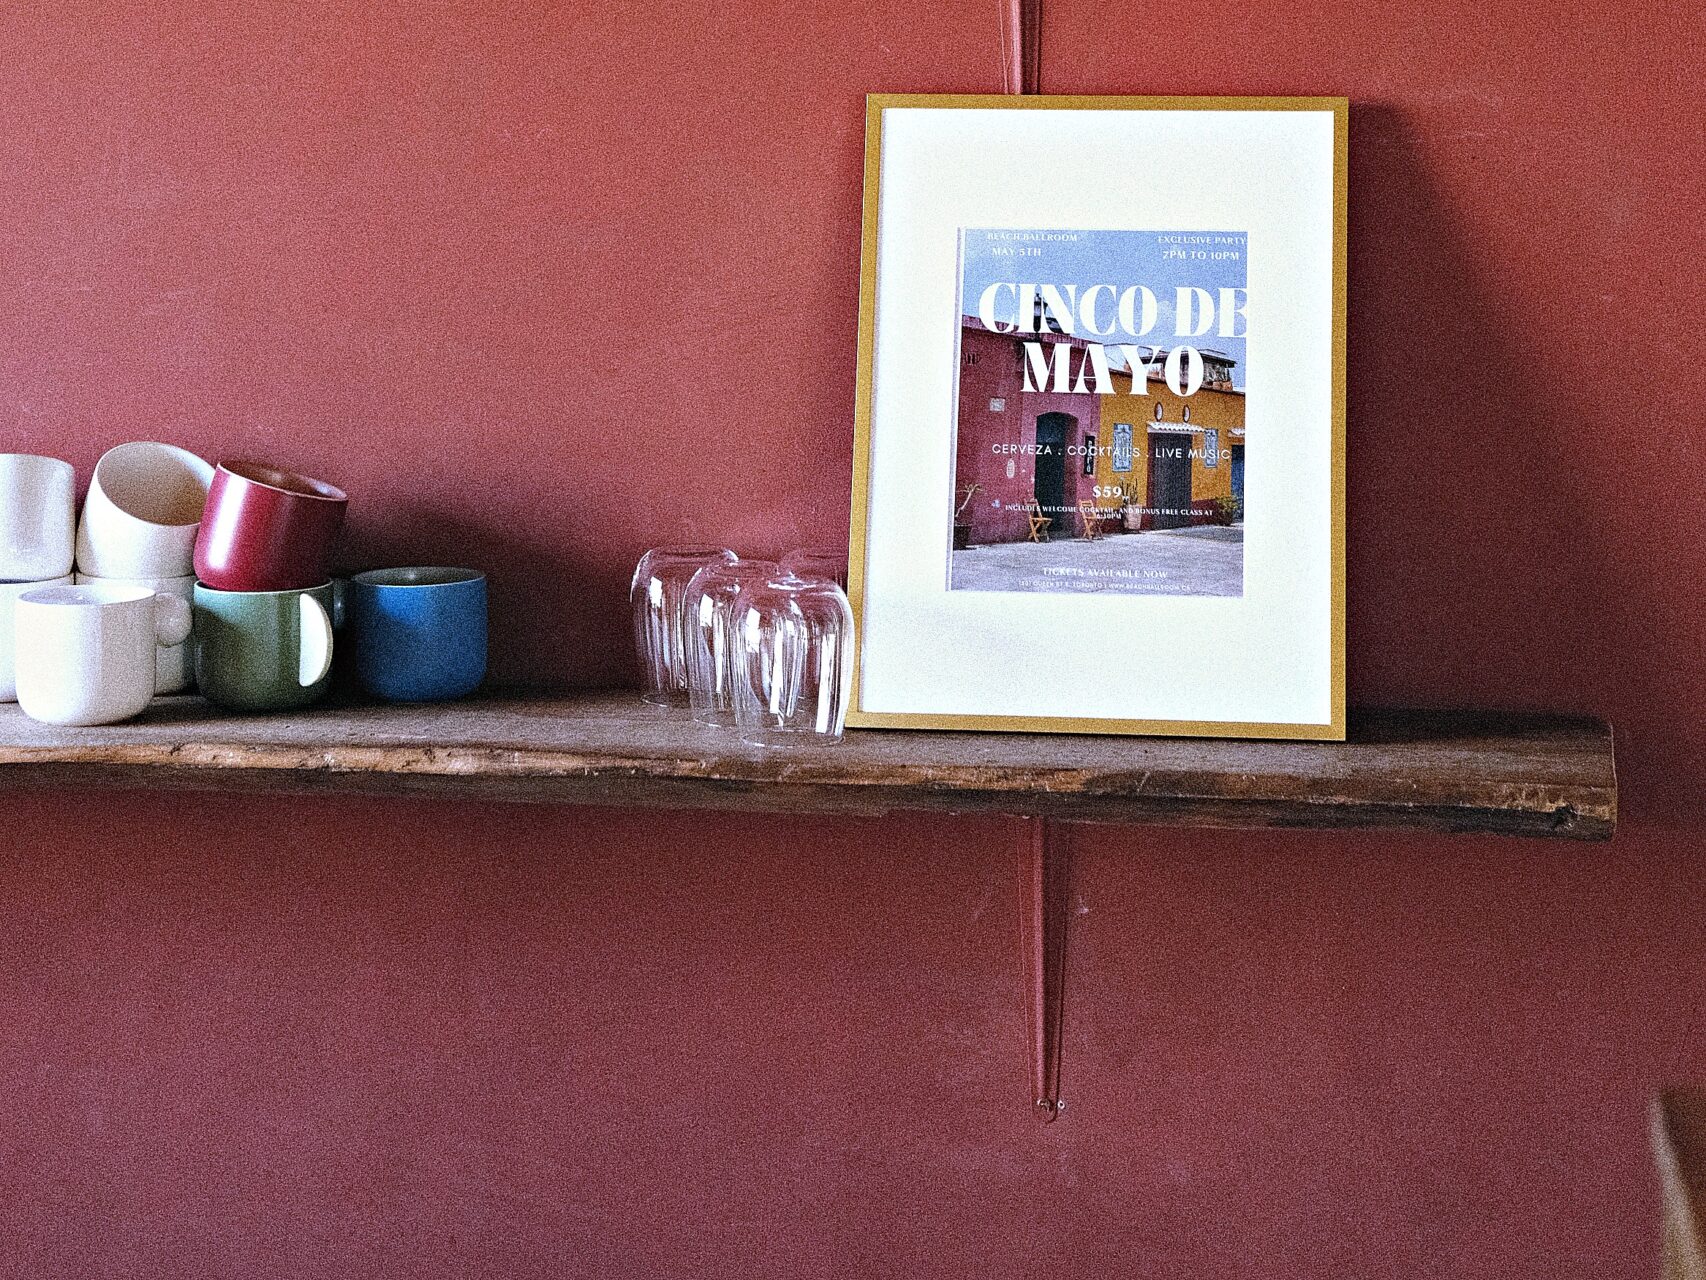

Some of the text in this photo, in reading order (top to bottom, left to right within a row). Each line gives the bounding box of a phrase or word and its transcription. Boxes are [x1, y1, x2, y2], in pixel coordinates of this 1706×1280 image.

[987, 232, 1077, 242] BEACH BALLROOM
[1158, 235, 1247, 245] EXCLUSIVE PARTY
[992, 247, 1042, 257] MAY 5TH
[1162, 250, 1240, 261] 7PM TO 10PM
[978, 282, 1157, 337] CINCO
[1020, 341, 1205, 397] MAYO
[991, 443, 1053, 456] CERVEZA
[1067, 445, 1141, 458] COCKTAILS
[1155, 447, 1182, 458] LIVE
[1187, 448, 1231, 460] MUSIC
[1092, 485, 1122, 498] $59
[1005, 504, 1040, 512] INCLUDES
[1042, 505, 1077, 513] WELCOME
[1119, 507, 1134, 515] AND
[1136, 508, 1160, 516] BONUS
[1161, 508, 1179, 516] FREE
[1180, 508, 1203, 517] CLASS
[1204, 509, 1214, 517] AT
[1043, 567, 1169, 580] TICKETS AVAILABLE NOW
[1072, 581, 1103, 589] TORONTO
